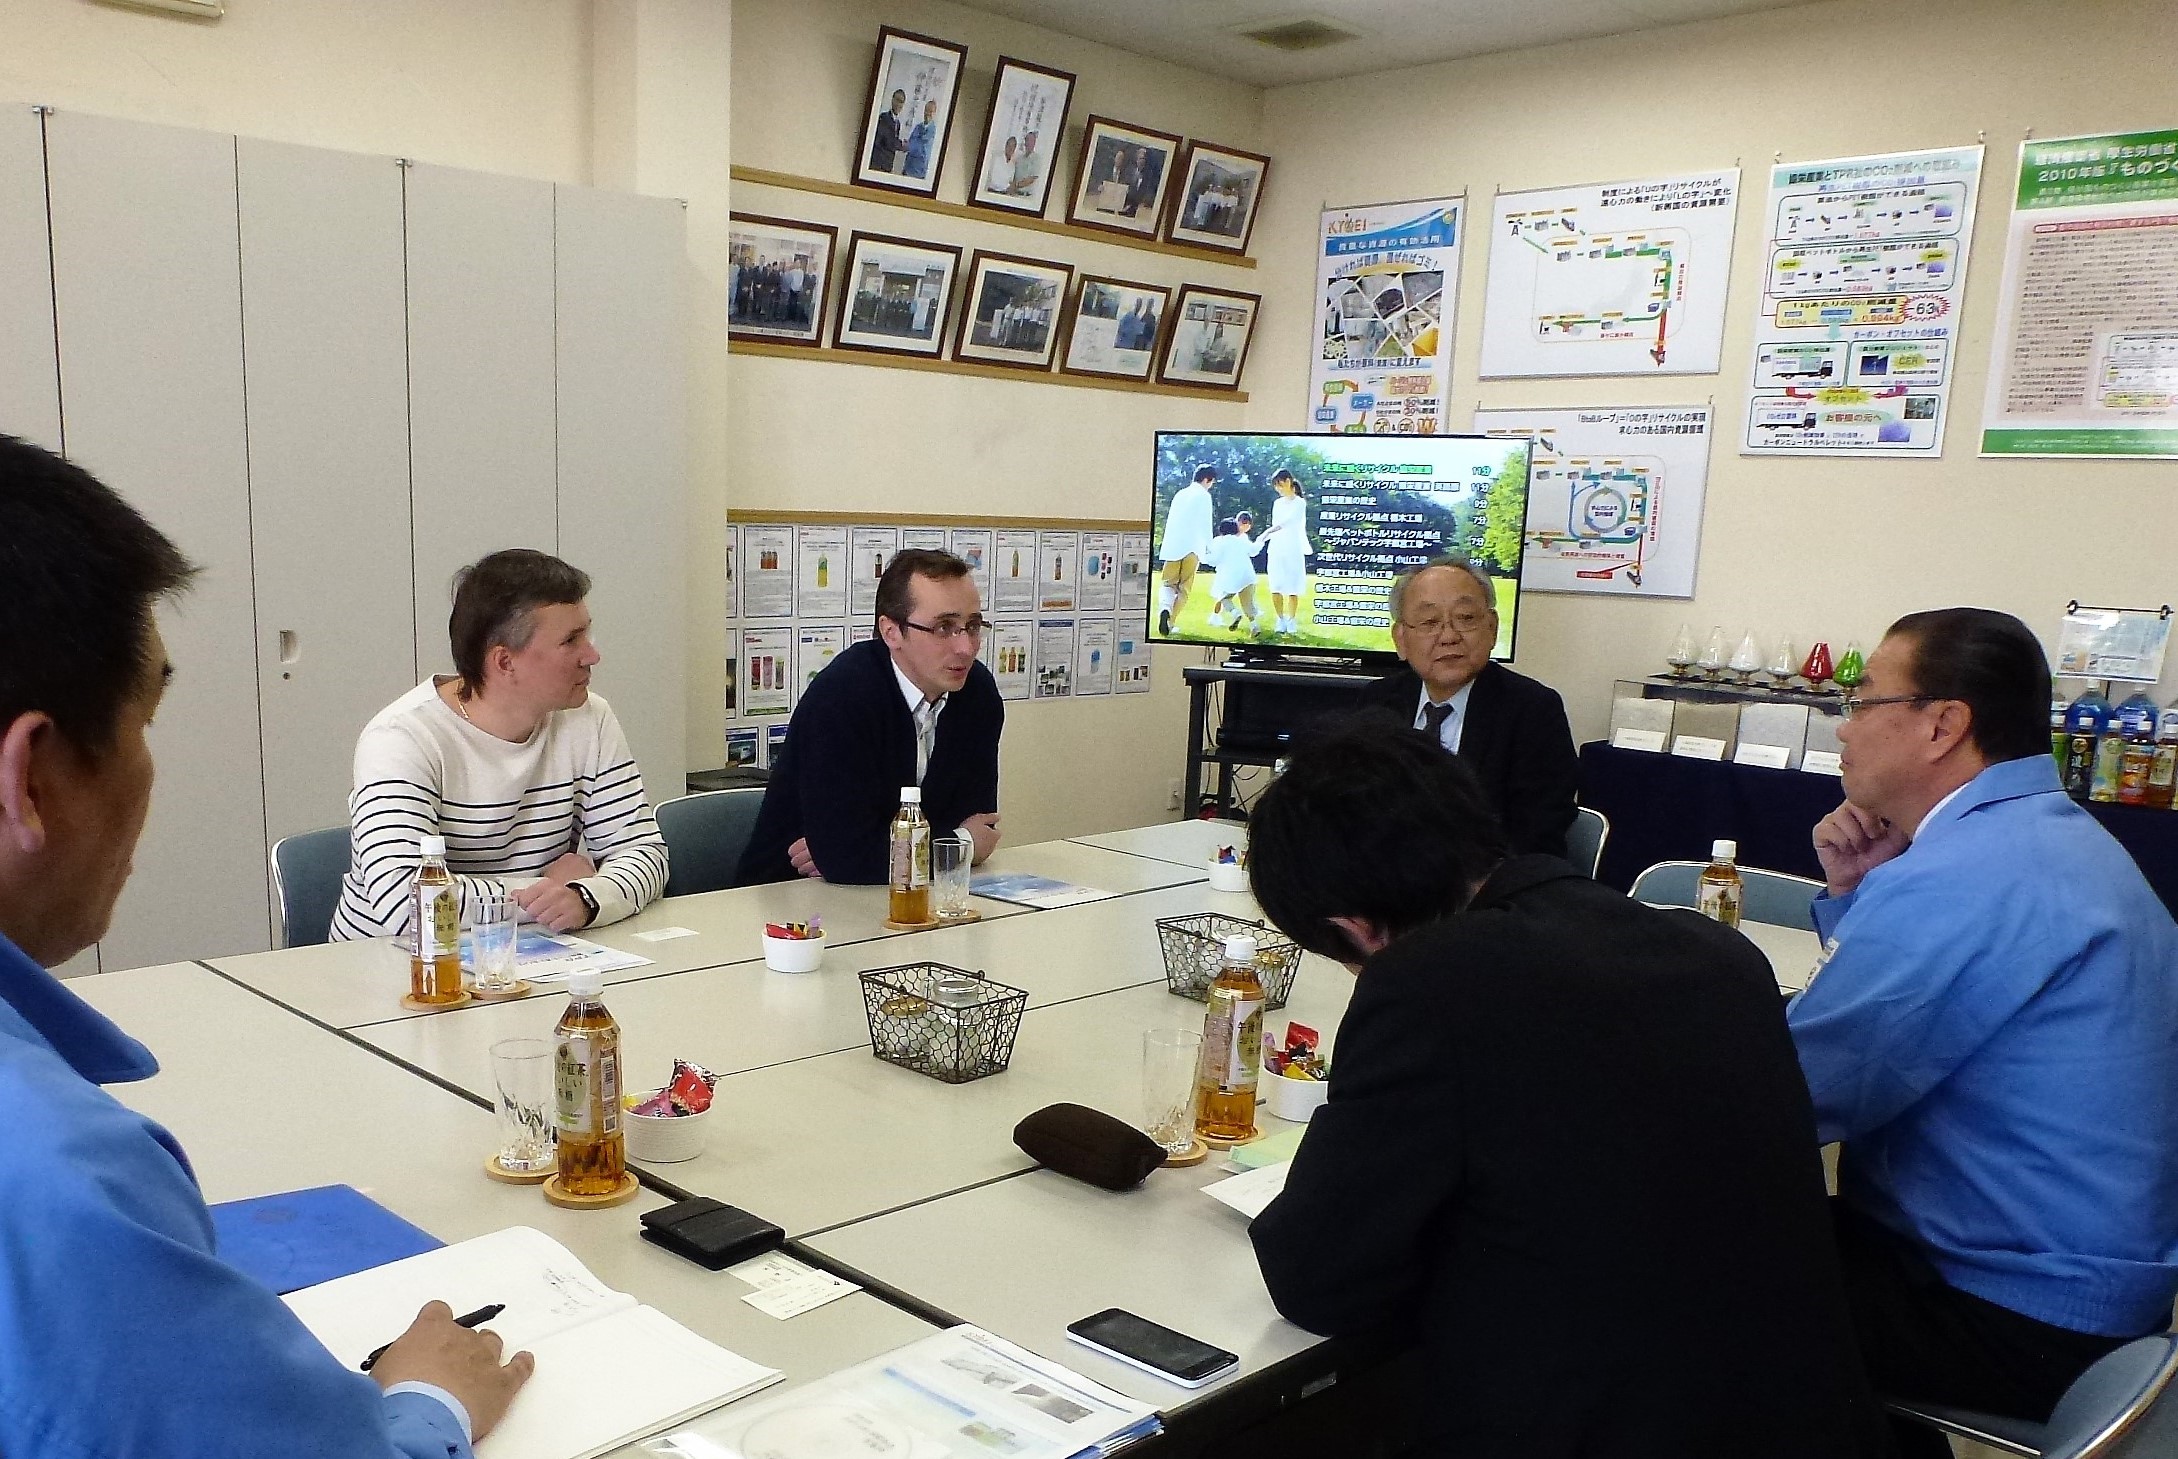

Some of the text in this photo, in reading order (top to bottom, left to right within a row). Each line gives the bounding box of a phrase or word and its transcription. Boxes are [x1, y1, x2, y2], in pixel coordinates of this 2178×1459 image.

[1472, 466, 1491, 476] 11分
[1471, 483, 1489, 493] 11分
[1474, 499, 1488, 509] 9分
[1473, 516, 1487, 525] 7分
[1471, 537, 1485, 547] 7分
